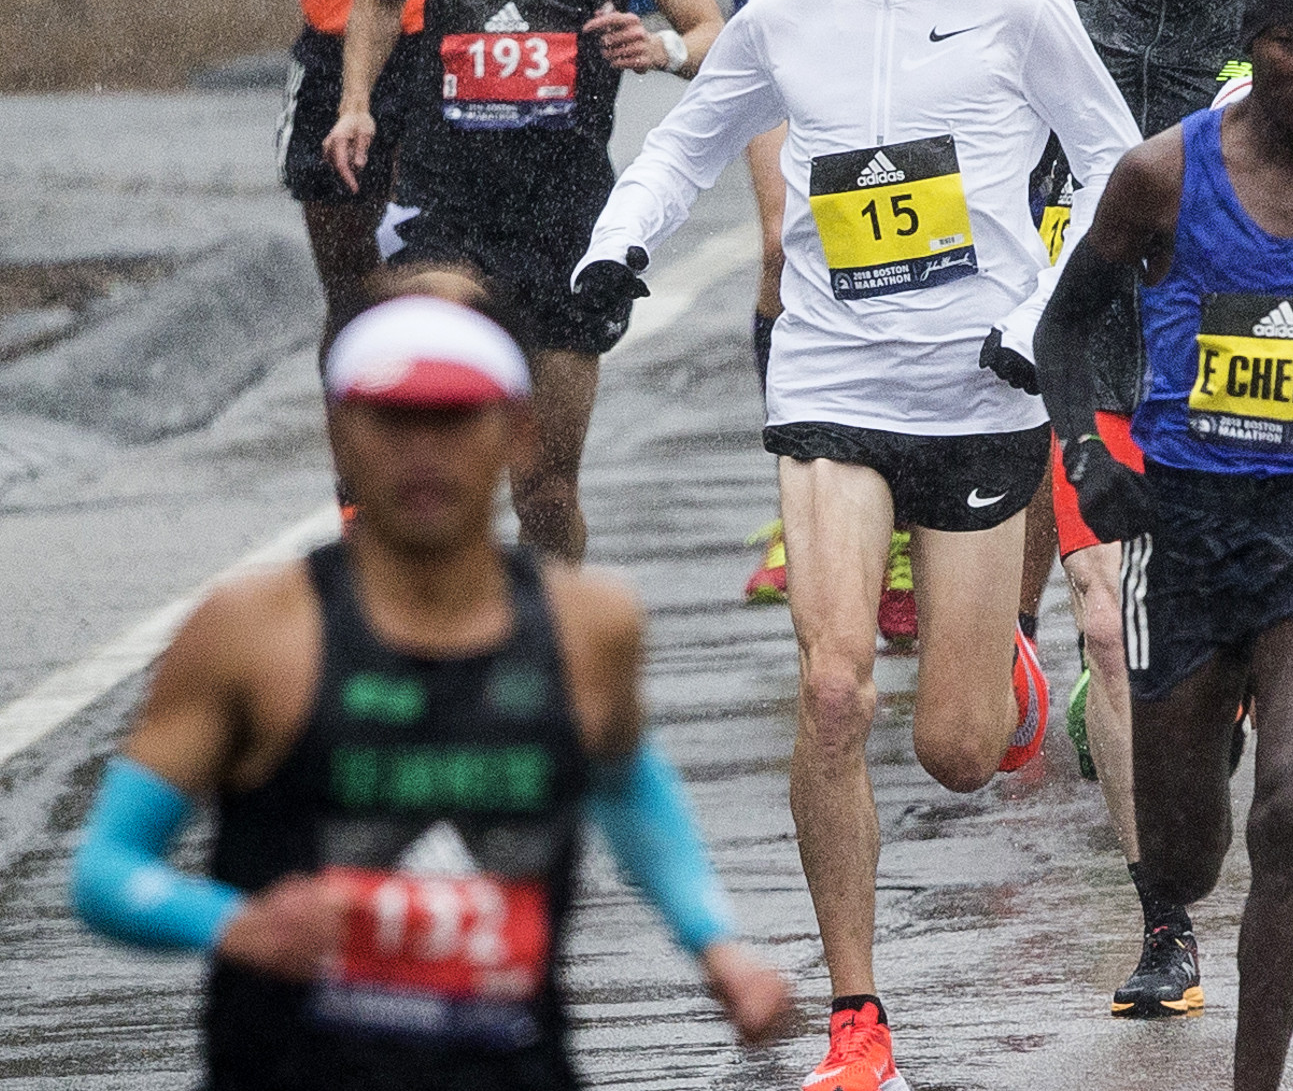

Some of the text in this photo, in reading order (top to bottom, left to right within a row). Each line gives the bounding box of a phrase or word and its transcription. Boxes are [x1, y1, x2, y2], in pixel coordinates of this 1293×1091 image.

[468, 37, 550, 80] 193
[857, 170, 906, 188] adidas
[861, 193, 920, 241] 15
[852, 270, 872, 281] 2018
[872, 264, 910, 278] BOSTON
[854, 273, 912, 290] MARATHON
[1200, 349, 1220, 396] E
[1218, 426, 1283, 444] MARATHON
[1243, 419, 1283, 434] BOSTON
